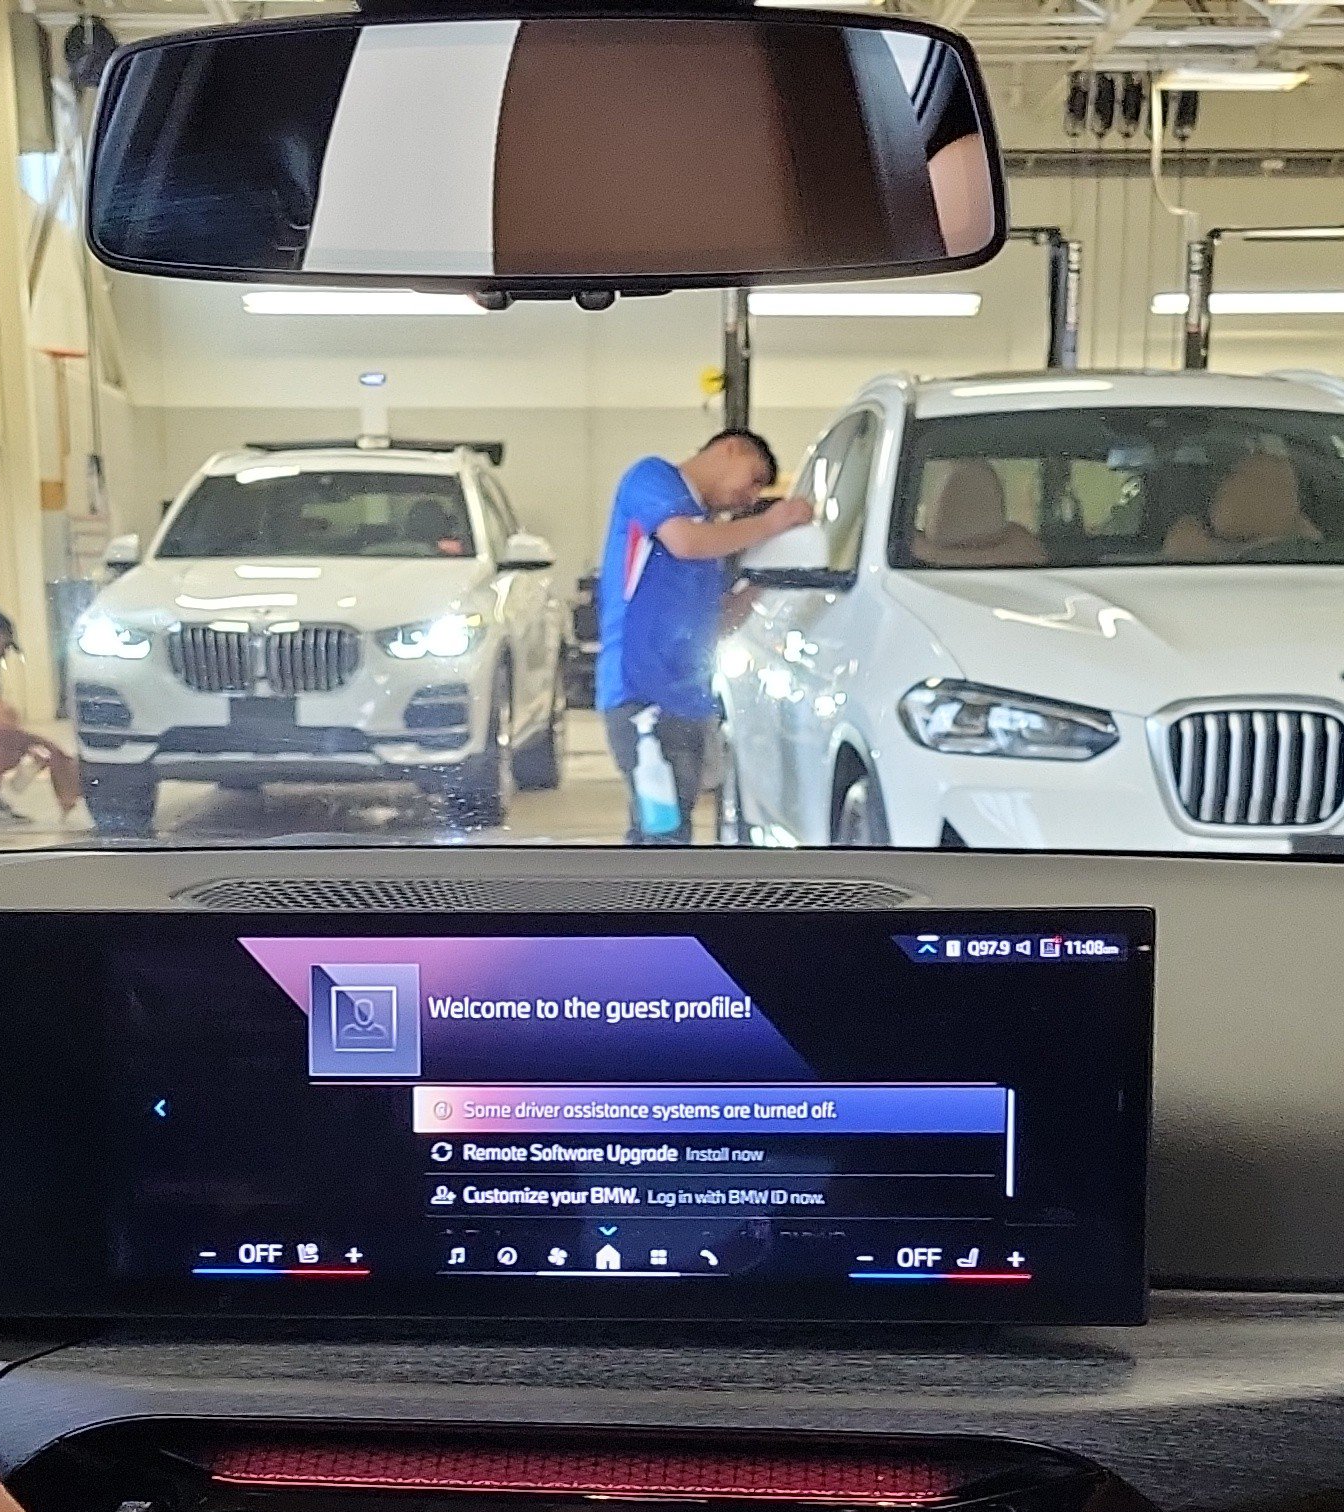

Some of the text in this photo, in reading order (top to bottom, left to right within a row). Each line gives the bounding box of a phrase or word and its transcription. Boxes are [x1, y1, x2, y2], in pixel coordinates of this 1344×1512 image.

[967, 940, 1010, 956] Q97.9
[428, 996, 751, 1023] Welcome to the guest profile!
[463, 1101, 838, 1121] Some driver assistance systems are turned off.
[463, 1144, 765, 1165] Remote Software Upgrade Install now
[463, 1186, 825, 1207] Customize your BMW. Log in with BMW ID now.
[238, 1243, 283, 1263] OFF
[897, 1248, 942, 1267] OFF
